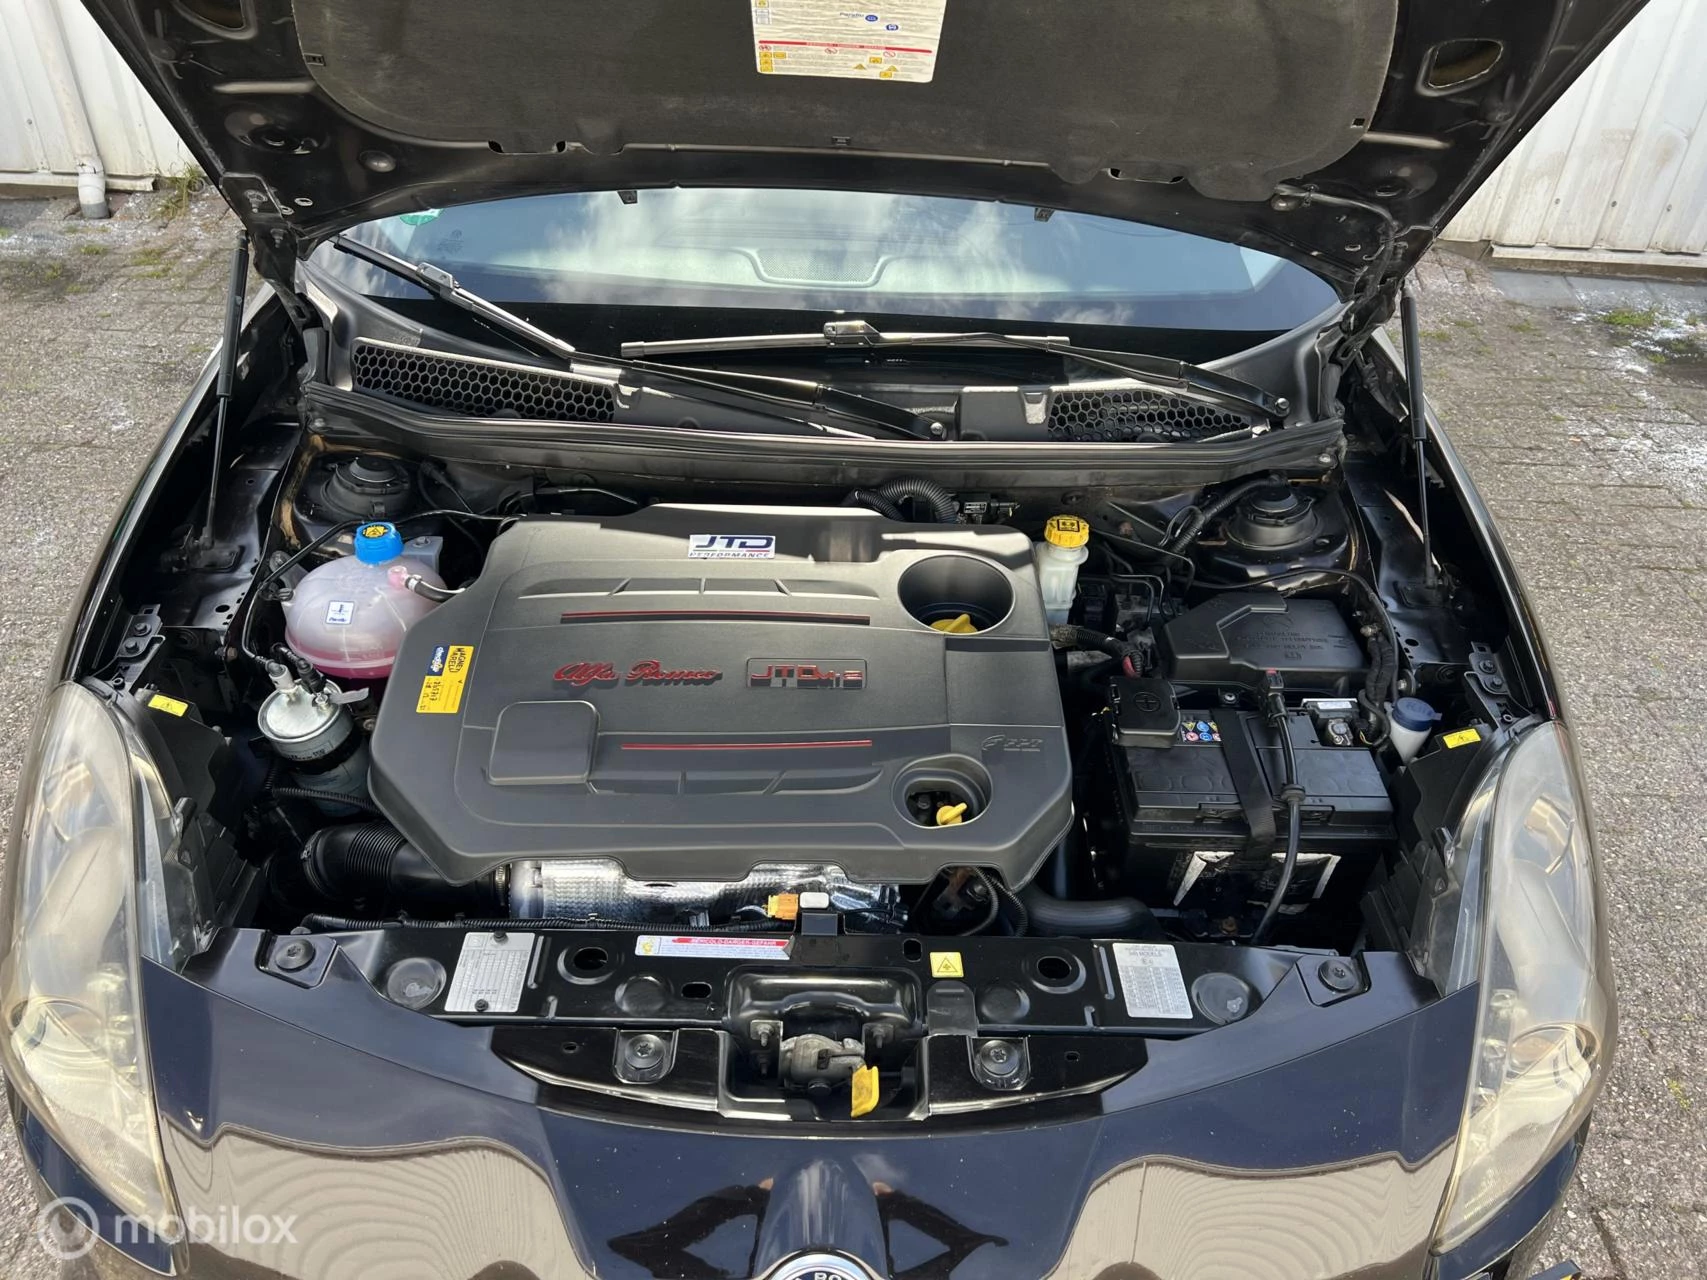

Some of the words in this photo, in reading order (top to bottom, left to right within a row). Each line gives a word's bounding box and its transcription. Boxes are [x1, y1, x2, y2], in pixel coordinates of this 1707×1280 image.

[695, 535, 774, 549] JTD
[553, 662, 617, 687] Alfa
[626, 659, 722, 684] Romeo
